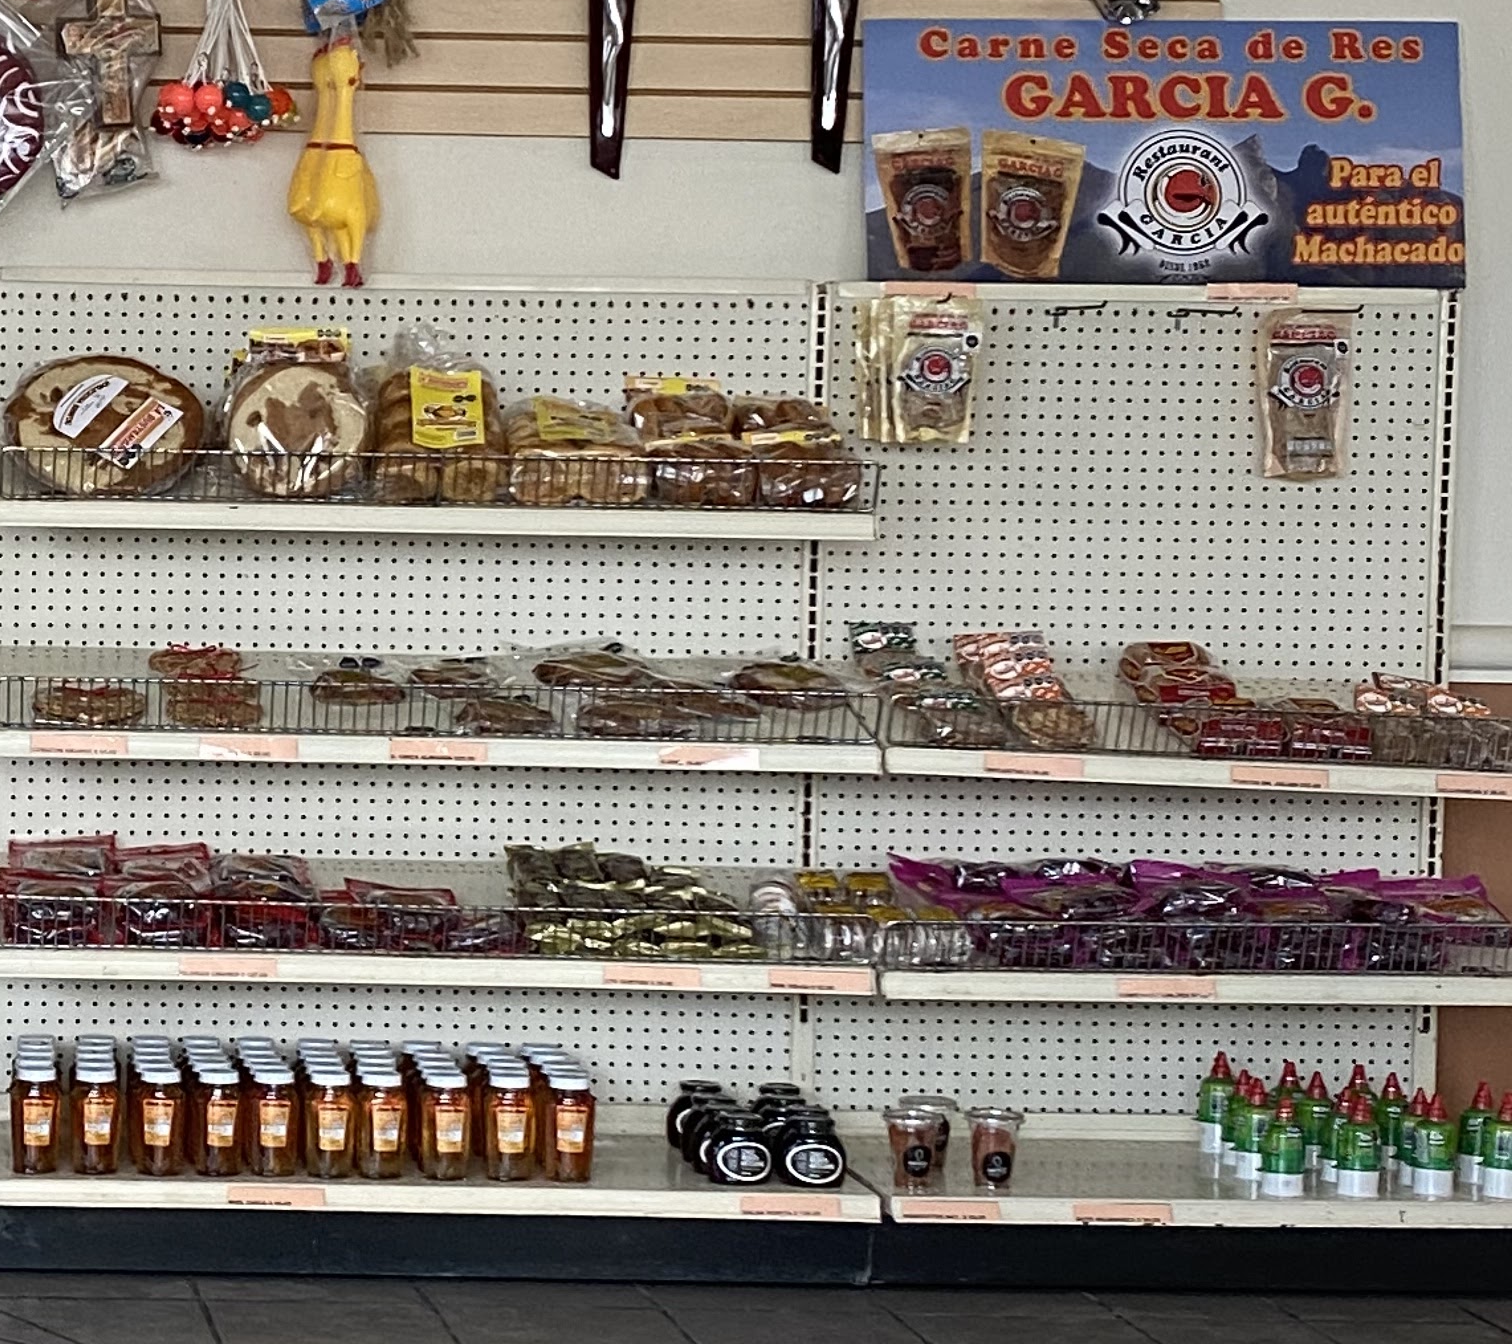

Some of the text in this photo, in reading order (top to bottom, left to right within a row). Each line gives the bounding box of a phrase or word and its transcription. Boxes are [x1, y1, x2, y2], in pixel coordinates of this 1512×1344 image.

[918, 27, 1422, 61] Carne Seca de Res
[1003, 72, 1375, 121] GARCIA G.
[1132, 142, 1230, 183] Restaurant
[1329, 157, 1442, 188] Para el
[1306, 195, 1457, 225] auténtico
[1140, 213, 1228, 245] GARCIA
[1292, 234, 1465, 264] Machacado
